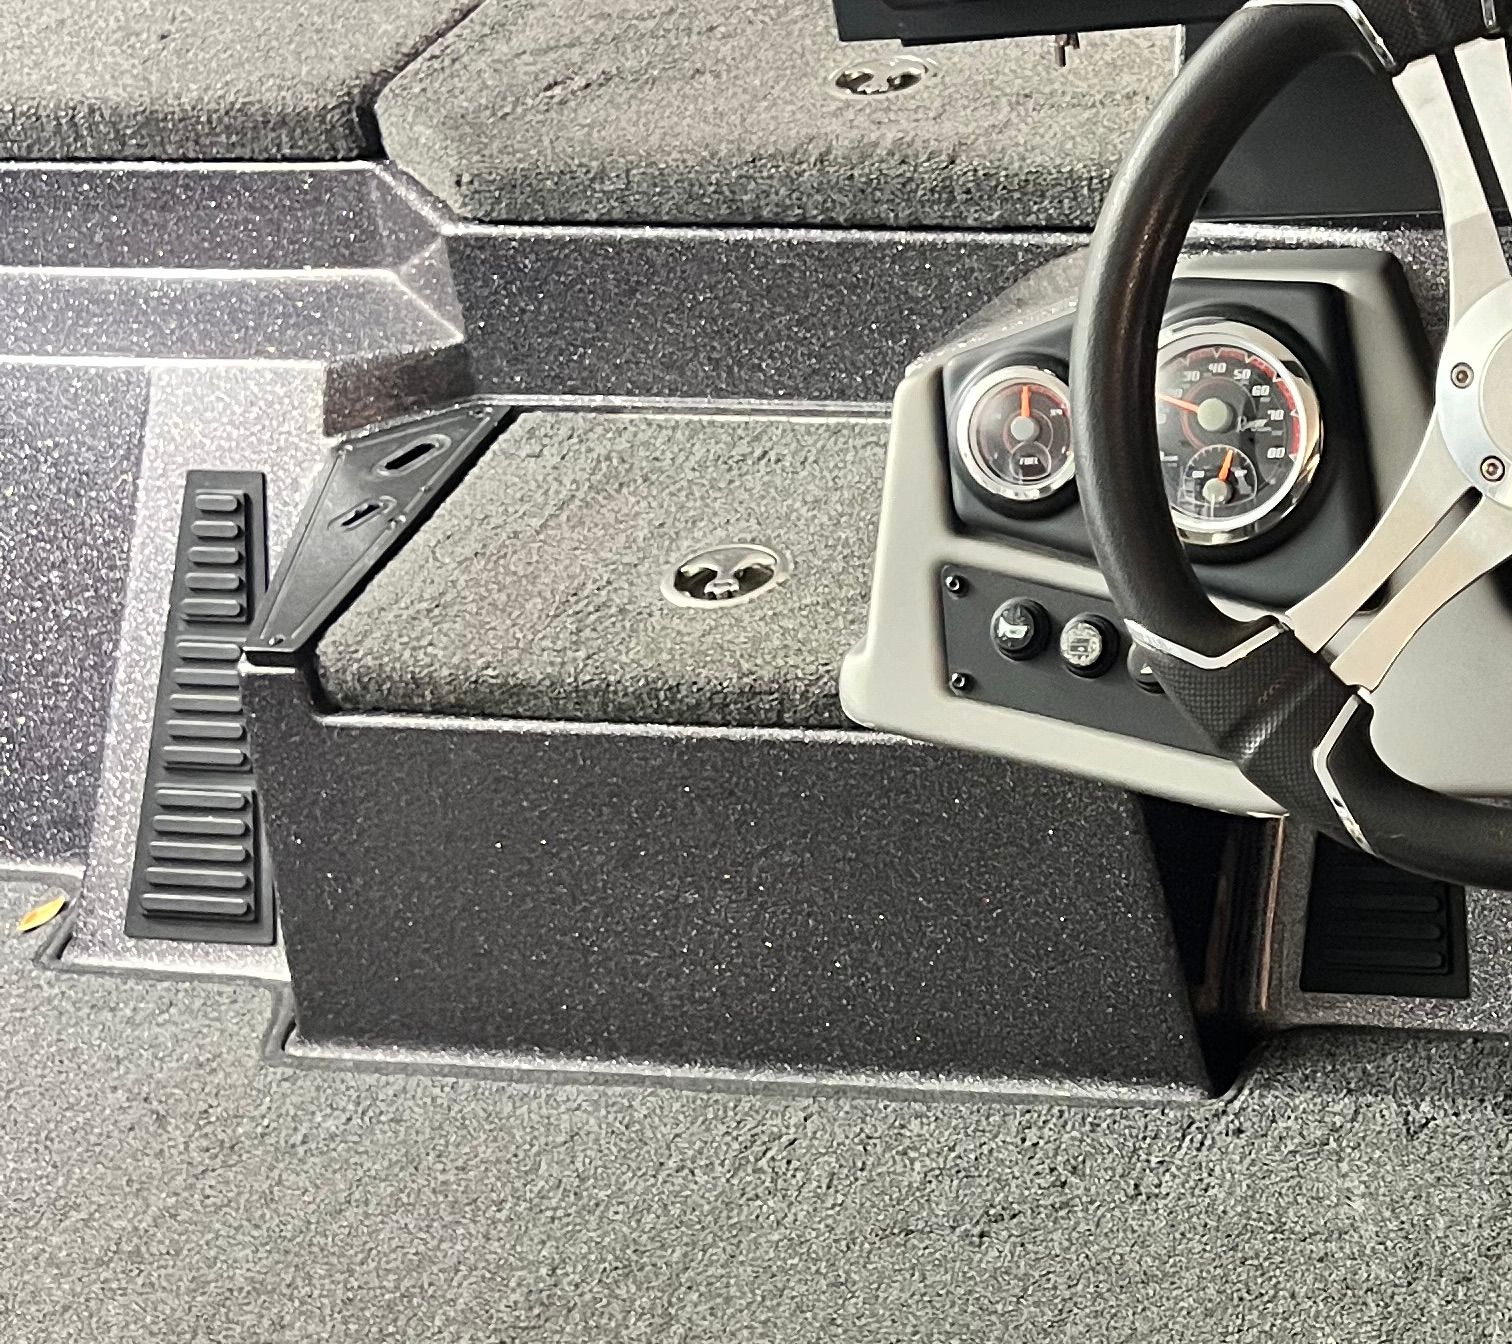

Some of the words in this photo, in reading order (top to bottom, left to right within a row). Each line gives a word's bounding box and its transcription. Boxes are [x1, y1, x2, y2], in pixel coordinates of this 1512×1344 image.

[1208, 362, 1227, 374] 40
[1233, 368, 1251, 380] 50
[1252, 385, 1270, 397] 60
[1267, 409, 1285, 421] 70
